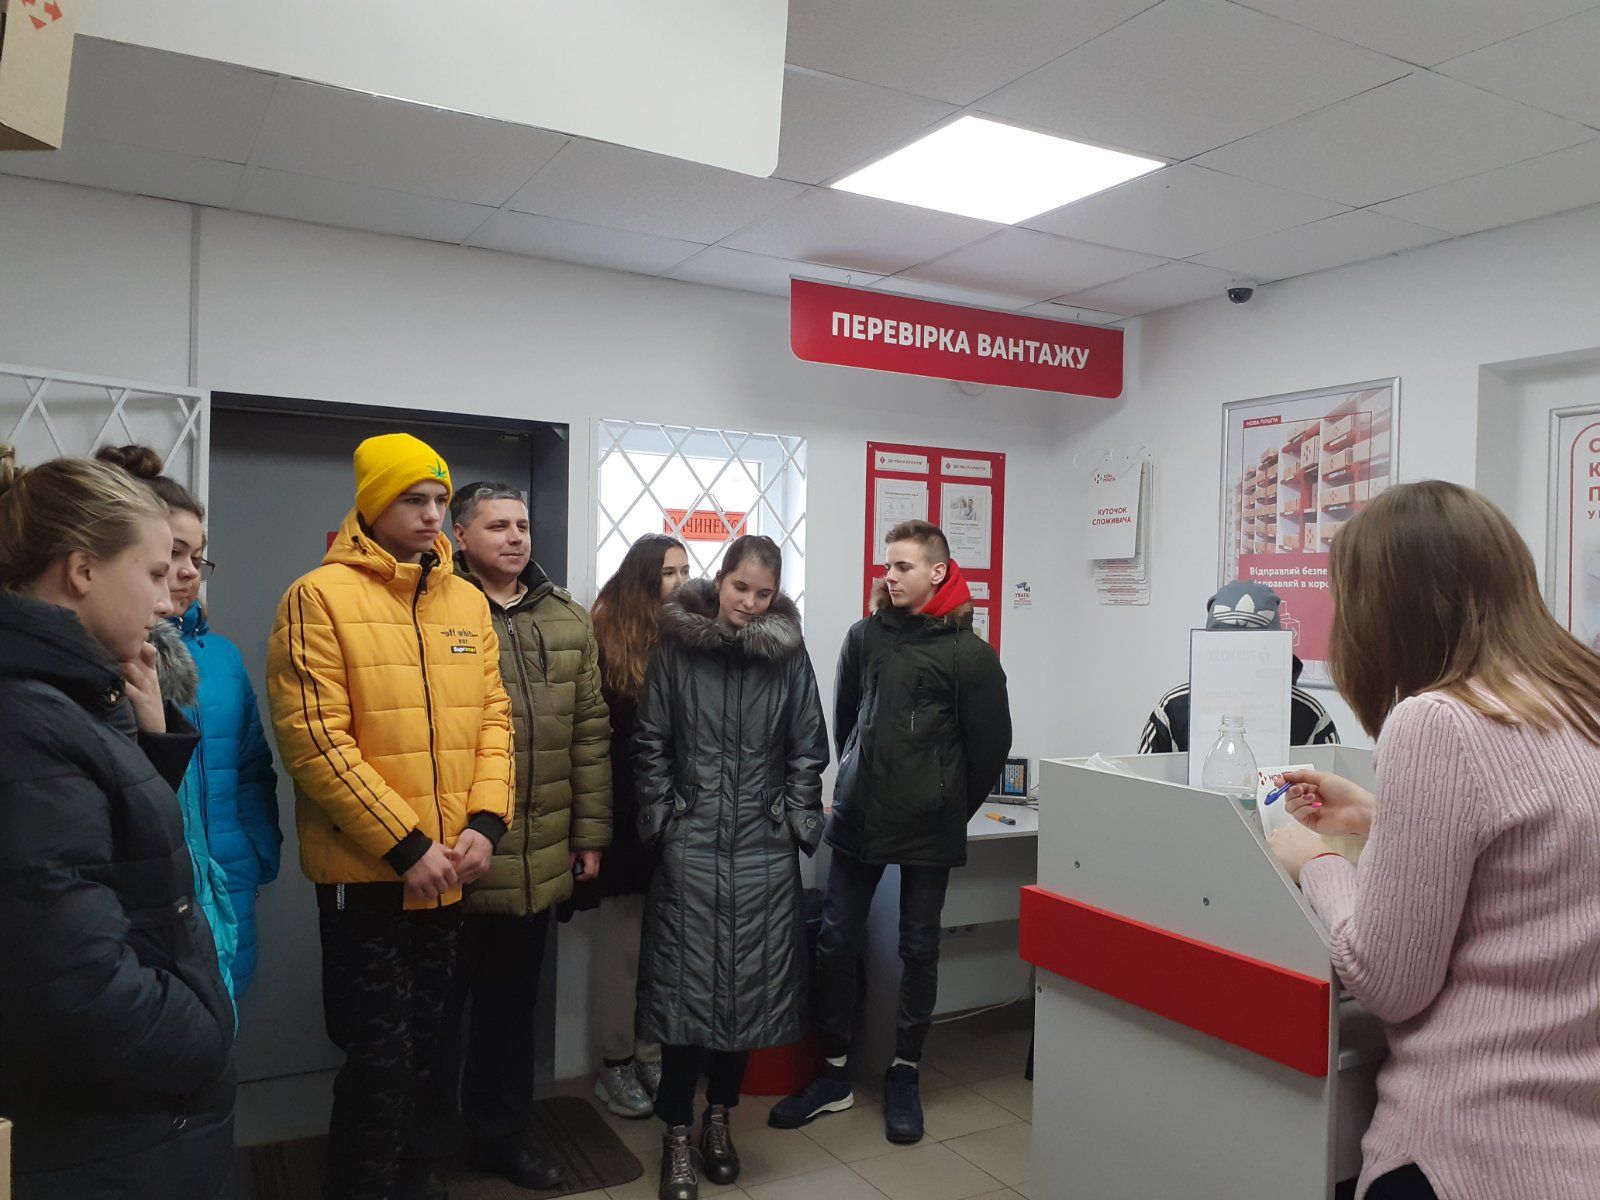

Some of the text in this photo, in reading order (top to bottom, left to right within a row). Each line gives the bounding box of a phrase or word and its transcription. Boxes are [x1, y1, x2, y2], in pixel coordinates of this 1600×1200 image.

[831, 311, 1090, 370] ПЕРЕВІРКА ВАНТАЖУ
[1097, 507, 1127, 516] КУТОЧОК
[1092, 516, 1132, 526] СПОЖИВАЧА
[1249, 566, 1300, 577] Відправляй
